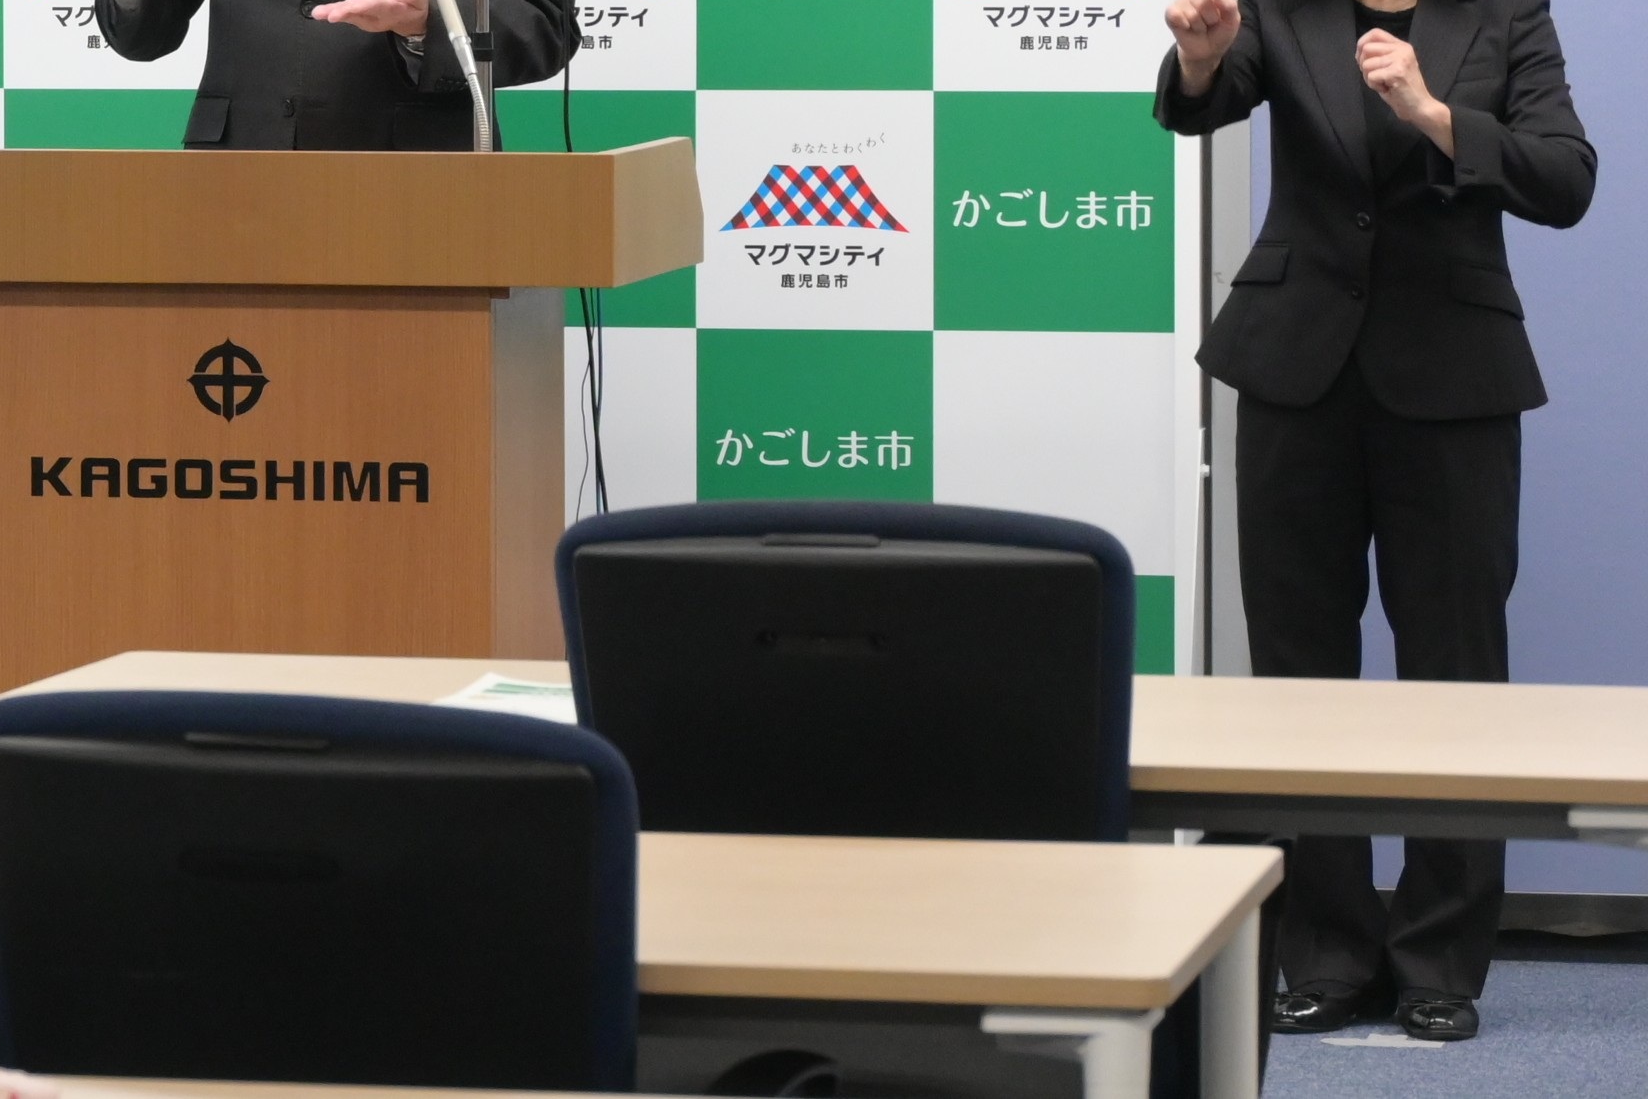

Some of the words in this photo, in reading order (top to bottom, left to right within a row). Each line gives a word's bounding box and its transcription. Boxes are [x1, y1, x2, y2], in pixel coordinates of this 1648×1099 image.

[983, 6, 1125, 27] マグマシティ
[1020, 36, 1088, 50] 鹿児島市
[791, 132, 886, 155] あなたとわくわく
[953, 189, 1153, 230] かごしま市
[745, 244, 884, 266] マグマシティ
[781, 274, 848, 288] 鹿児島市
[717, 428, 913, 470] かごしま市
[31, 457, 428, 502] KAGOSHIMA
